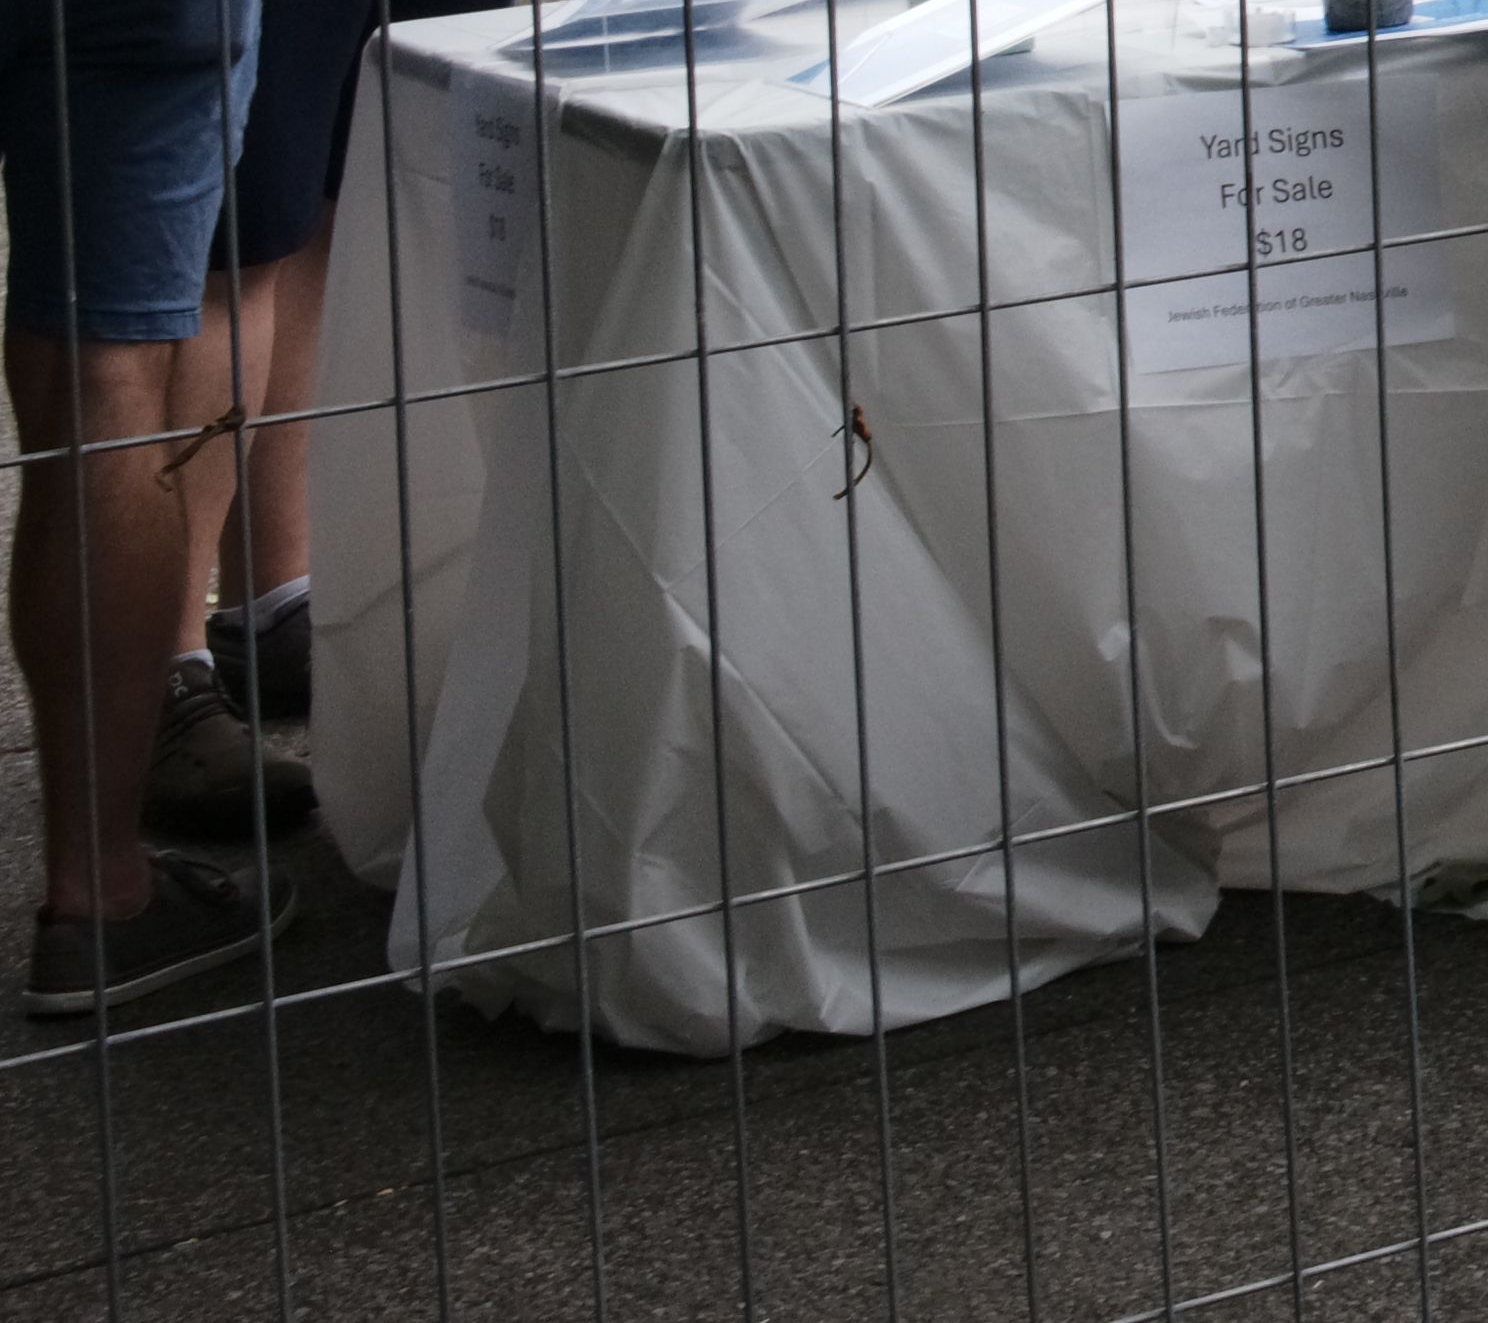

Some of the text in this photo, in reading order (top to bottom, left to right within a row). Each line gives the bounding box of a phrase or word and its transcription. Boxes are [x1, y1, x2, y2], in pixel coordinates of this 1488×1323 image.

[1200, 127, 1345, 160] Yard Signs
[1221, 175, 1334, 210] For Sale
[1255, 228, 1309, 257] $18
